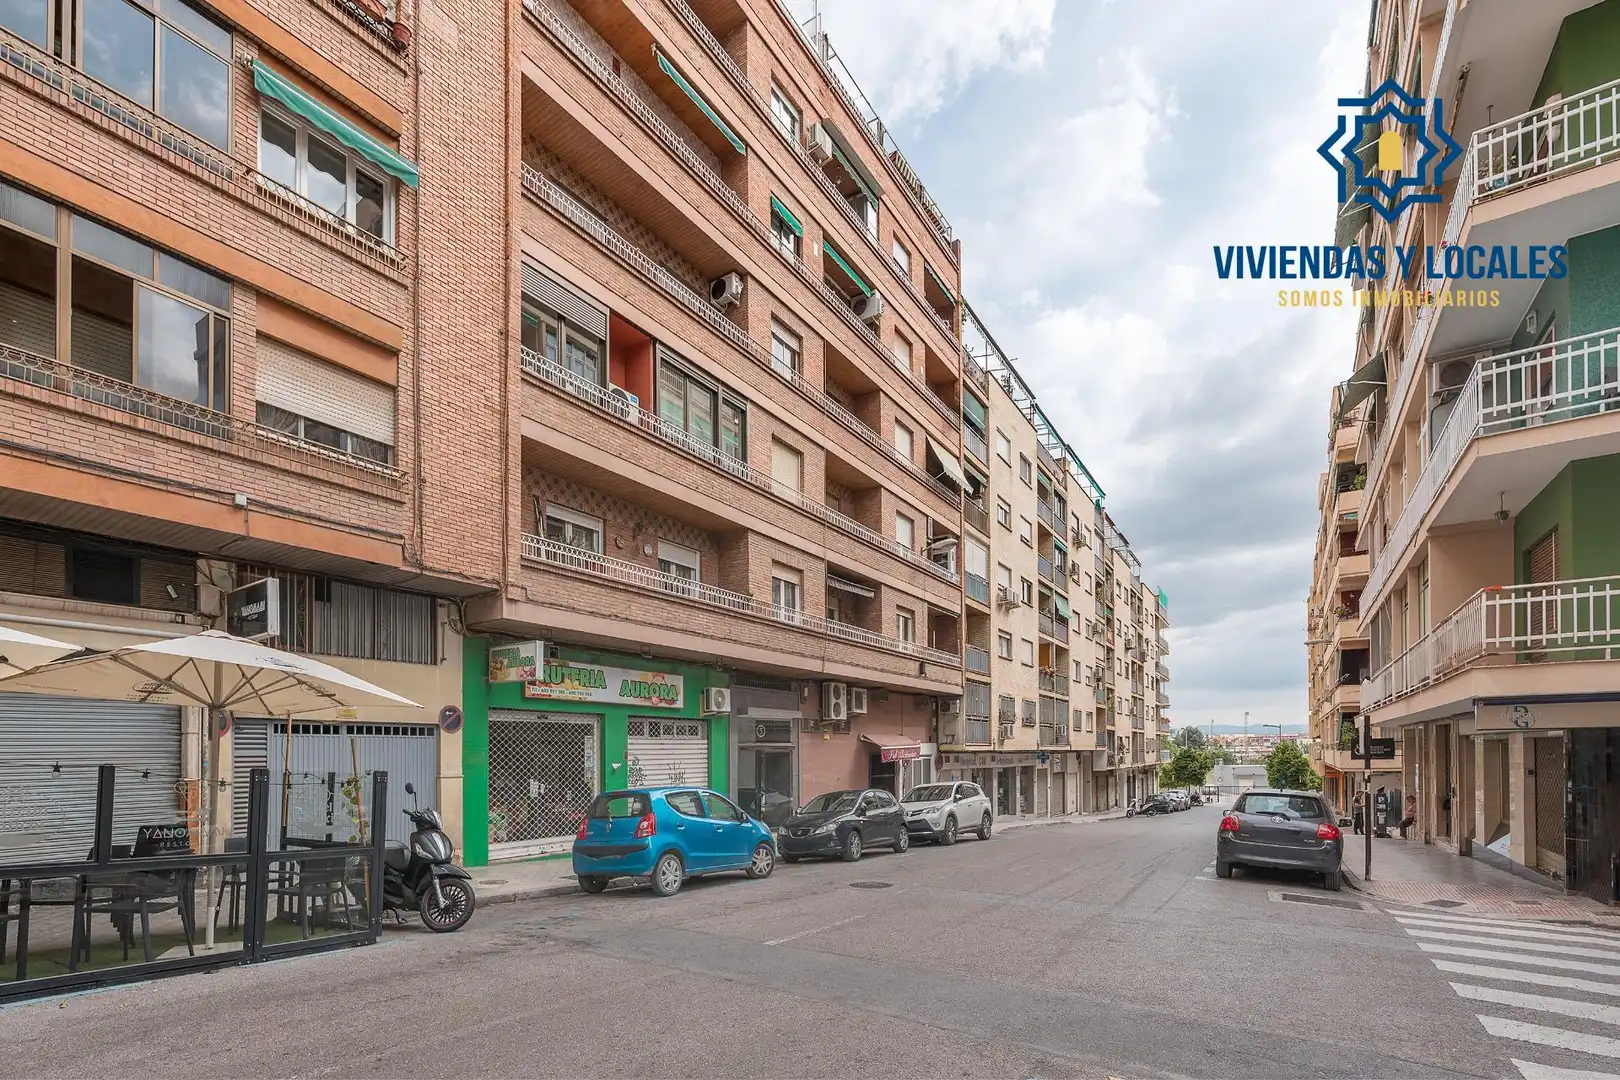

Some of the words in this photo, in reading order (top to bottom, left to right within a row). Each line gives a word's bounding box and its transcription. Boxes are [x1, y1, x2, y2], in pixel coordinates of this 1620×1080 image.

[506, 655, 536, 669] AURORA
[543, 664, 607, 690] RUTERIA
[619, 679, 679, 701] AURORA
